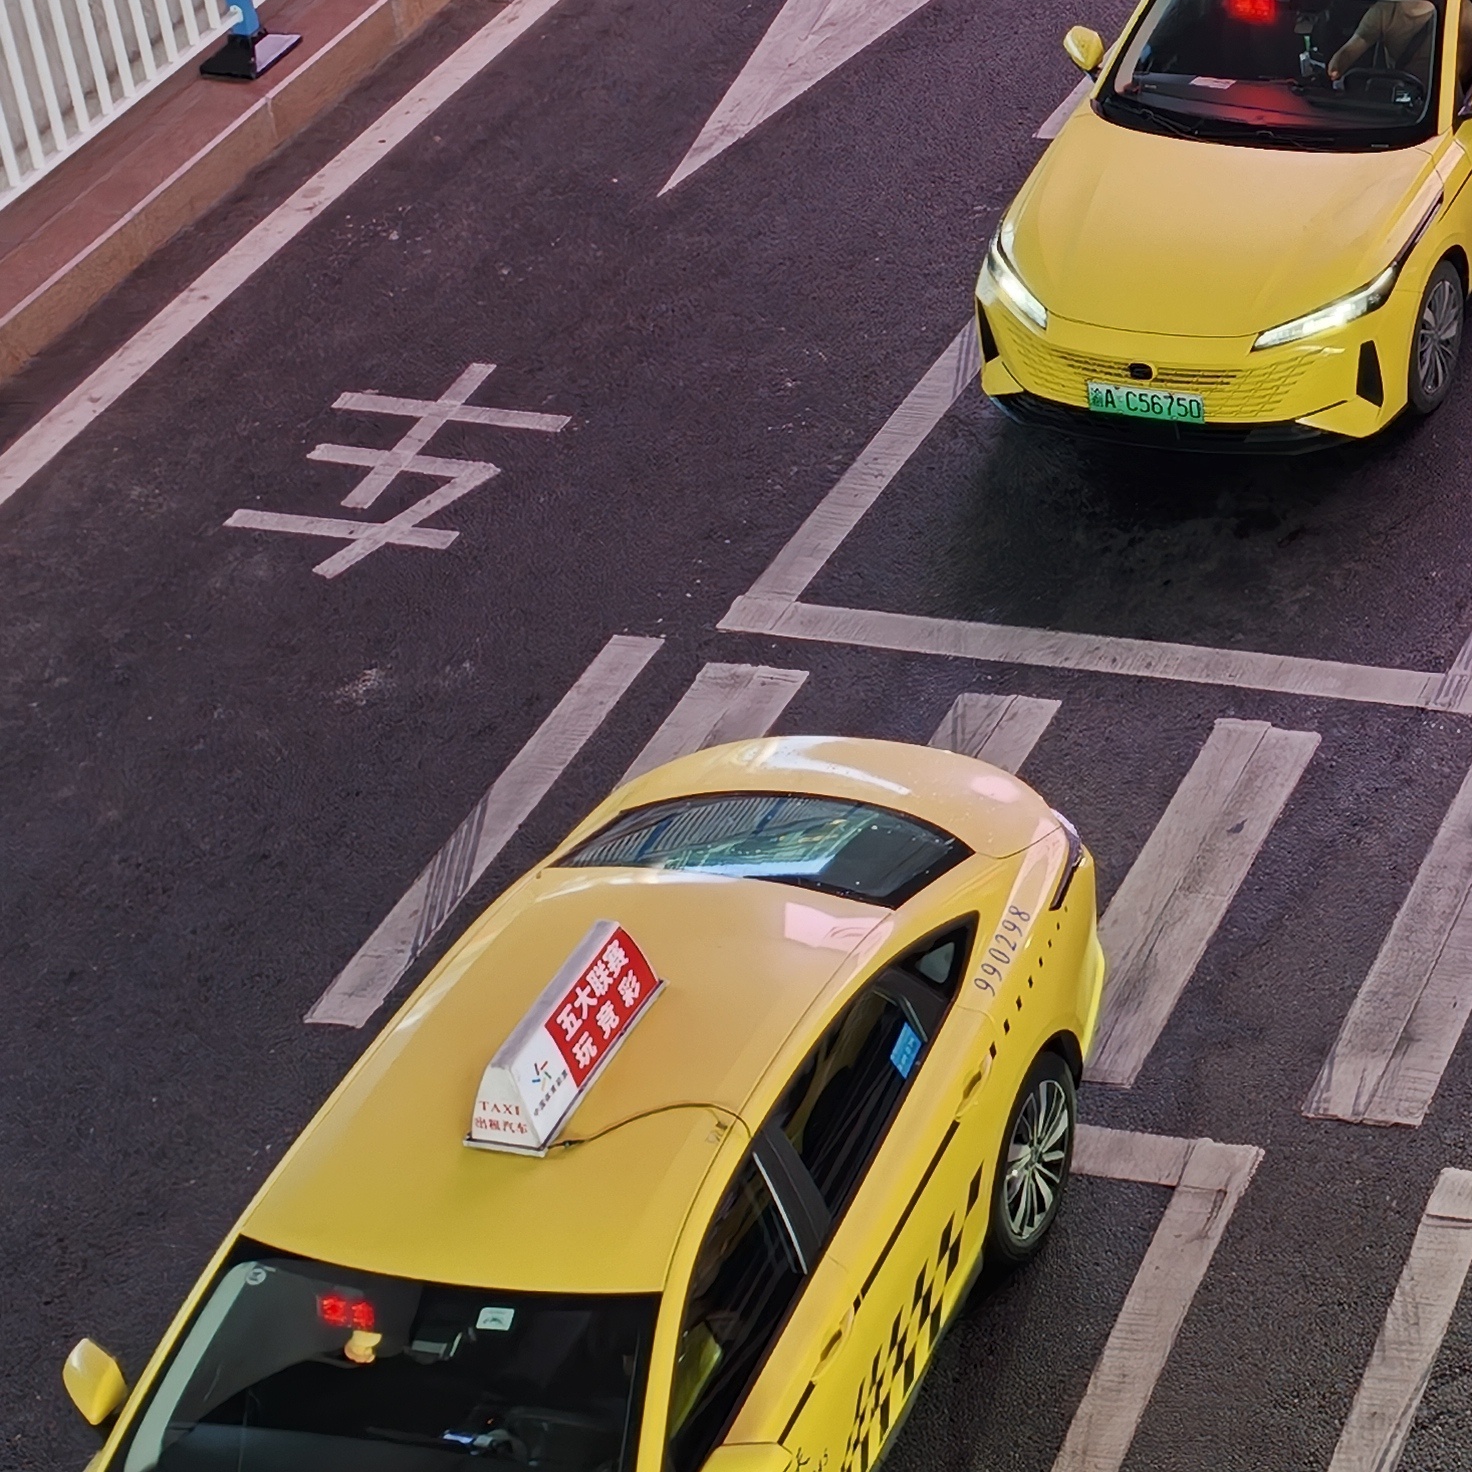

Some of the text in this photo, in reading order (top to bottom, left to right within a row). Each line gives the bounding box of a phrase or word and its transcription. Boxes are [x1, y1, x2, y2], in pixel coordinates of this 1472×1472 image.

[1125, 391, 1201, 419] C56750
[555, 938, 630, 1042] 五大联赛
[974, 904, 1031, 997] 990298
[571, 968, 641, 1069] 玩竞彩
[479, 1100, 521, 1116] TAXI
